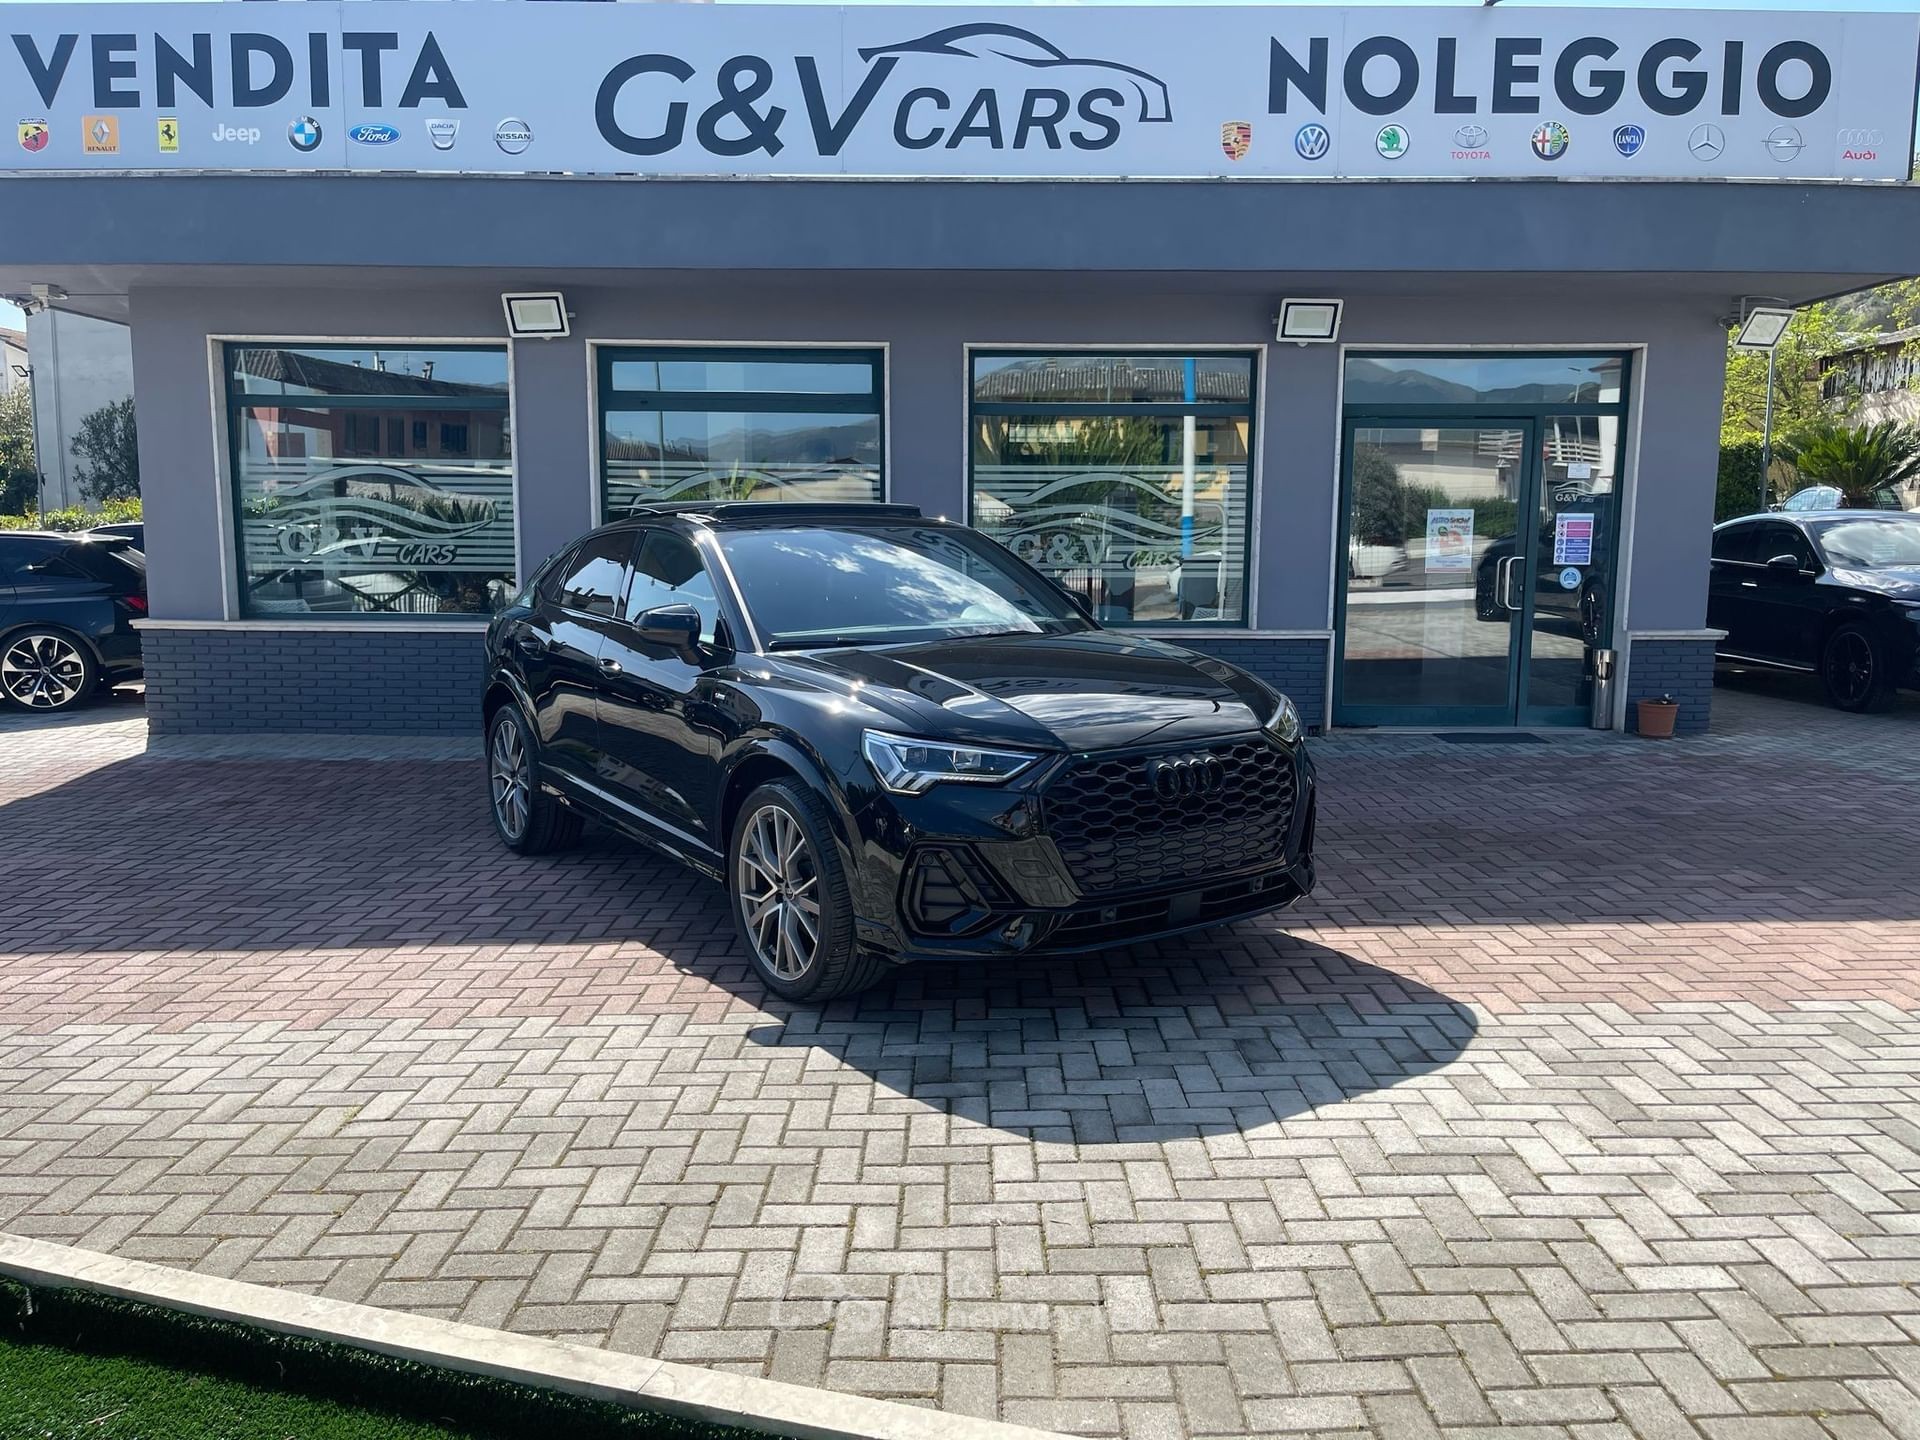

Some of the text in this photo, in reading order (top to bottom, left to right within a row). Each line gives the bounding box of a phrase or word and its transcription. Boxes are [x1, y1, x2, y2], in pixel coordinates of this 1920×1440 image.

[10, 30, 469, 110] VENDITA
[1268, 35, 1832, 119] NOLEGGIO
[594, 53, 1125, 158] G&V CARS
[211, 123, 261, 145] Jeep
[357, 126, 391, 142] Ford
[496, 132, 531, 140] NISSAN
[1616, 134, 1640, 145] LANCIA
[1450, 151, 1491, 160] TOYOTA
[1842, 149, 1877, 160] Audi
[399, 543, 456, 565] CARS
[1127, 549, 1182, 570] CARS
